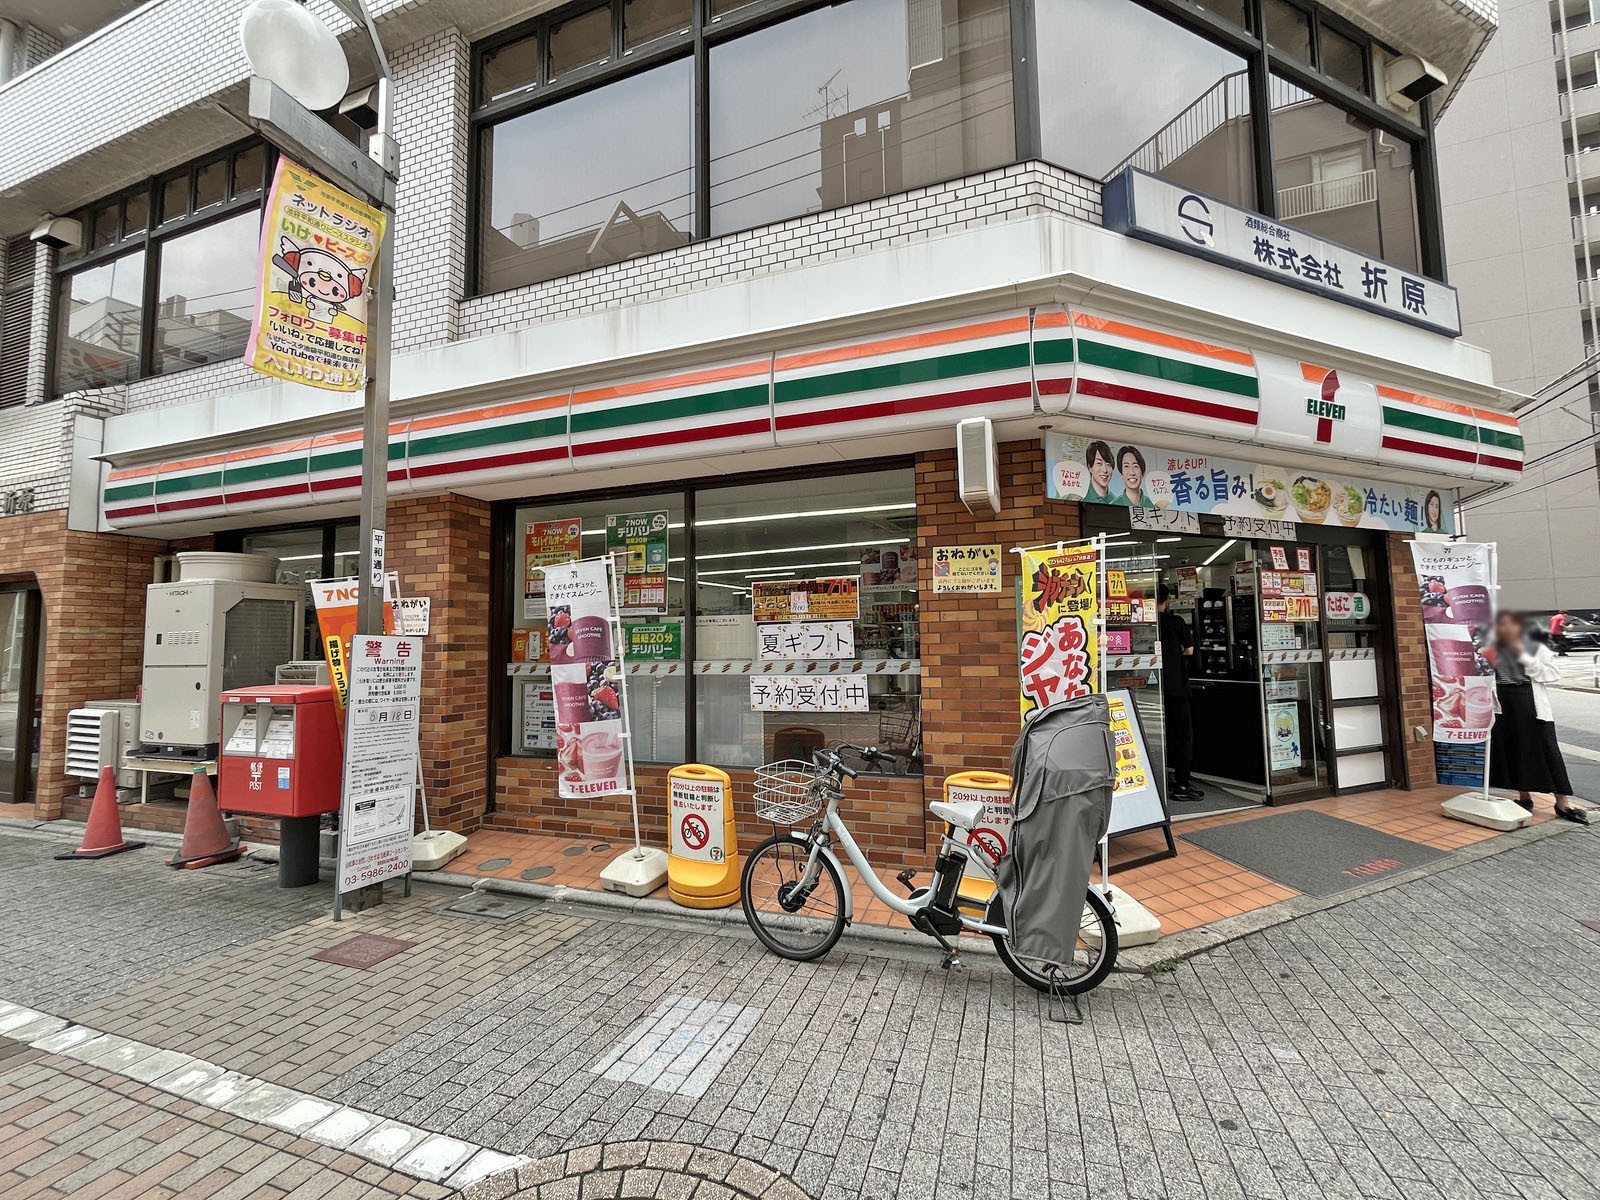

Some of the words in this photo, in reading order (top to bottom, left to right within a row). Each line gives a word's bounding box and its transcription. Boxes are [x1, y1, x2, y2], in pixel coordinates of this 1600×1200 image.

[292, 193, 372, 239] ネットラジオ
[281, 217, 311, 241] いけ
[1244, 216, 1291, 242] 酒類総合商社
[1253, 236, 1344, 290] 株式会社
[1360, 261, 1428, 316] 折原
[268, 306, 368, 346] フォロワー募集中
[264, 354, 360, 387] へいわ通り
[1167, 458, 1207, 471] 涼しさUP!
[1170, 469, 1255, 506] 香る旨み!
[1363, 487, 1425, 527] 冷たい麺!
[625, 518, 648, 526] 7NOW
[1223, 516, 1294, 536] 予約受付中
[543, 528, 563, 536] 7NOW
[617, 525, 659, 538] デリバリー
[373, 534, 383, 583] 平和通り
[936, 547, 996, 562] おねがい
[1420, 562, 1482, 570] できたてスムージー
[552, 581, 598, 591] くだものギュッと、
[1110, 580, 1124, 589] 7/1
[322, 587, 359, 602] 7NO
[549, 589, 603, 600] できたてスムージー
[1057, 598, 1093, 613] に登場!
[1327, 596, 1350, 612] たばこ
[1354, 596, 1364, 612] 酒
[631, 630, 674, 644] 最短20分
[761, 632, 849, 654] 夏ギフト
[365, 640, 412, 658] 警告
[631, 644, 673, 655] デリバリー
[373, 657, 405, 665] Warning
[752, 683, 866, 706] 予約受付中
[249, 781, 263, 791] POST
[672, 781, 720, 794] 20分以上の駐輪は
[673, 791, 720, 803] 無断駐輪と判断し
[952, 791, 1011, 804] 20分以上の駐輪
[673, 801, 717, 812] 撤去いたします。
[344, 859, 409, 886] 03-5986-2400
